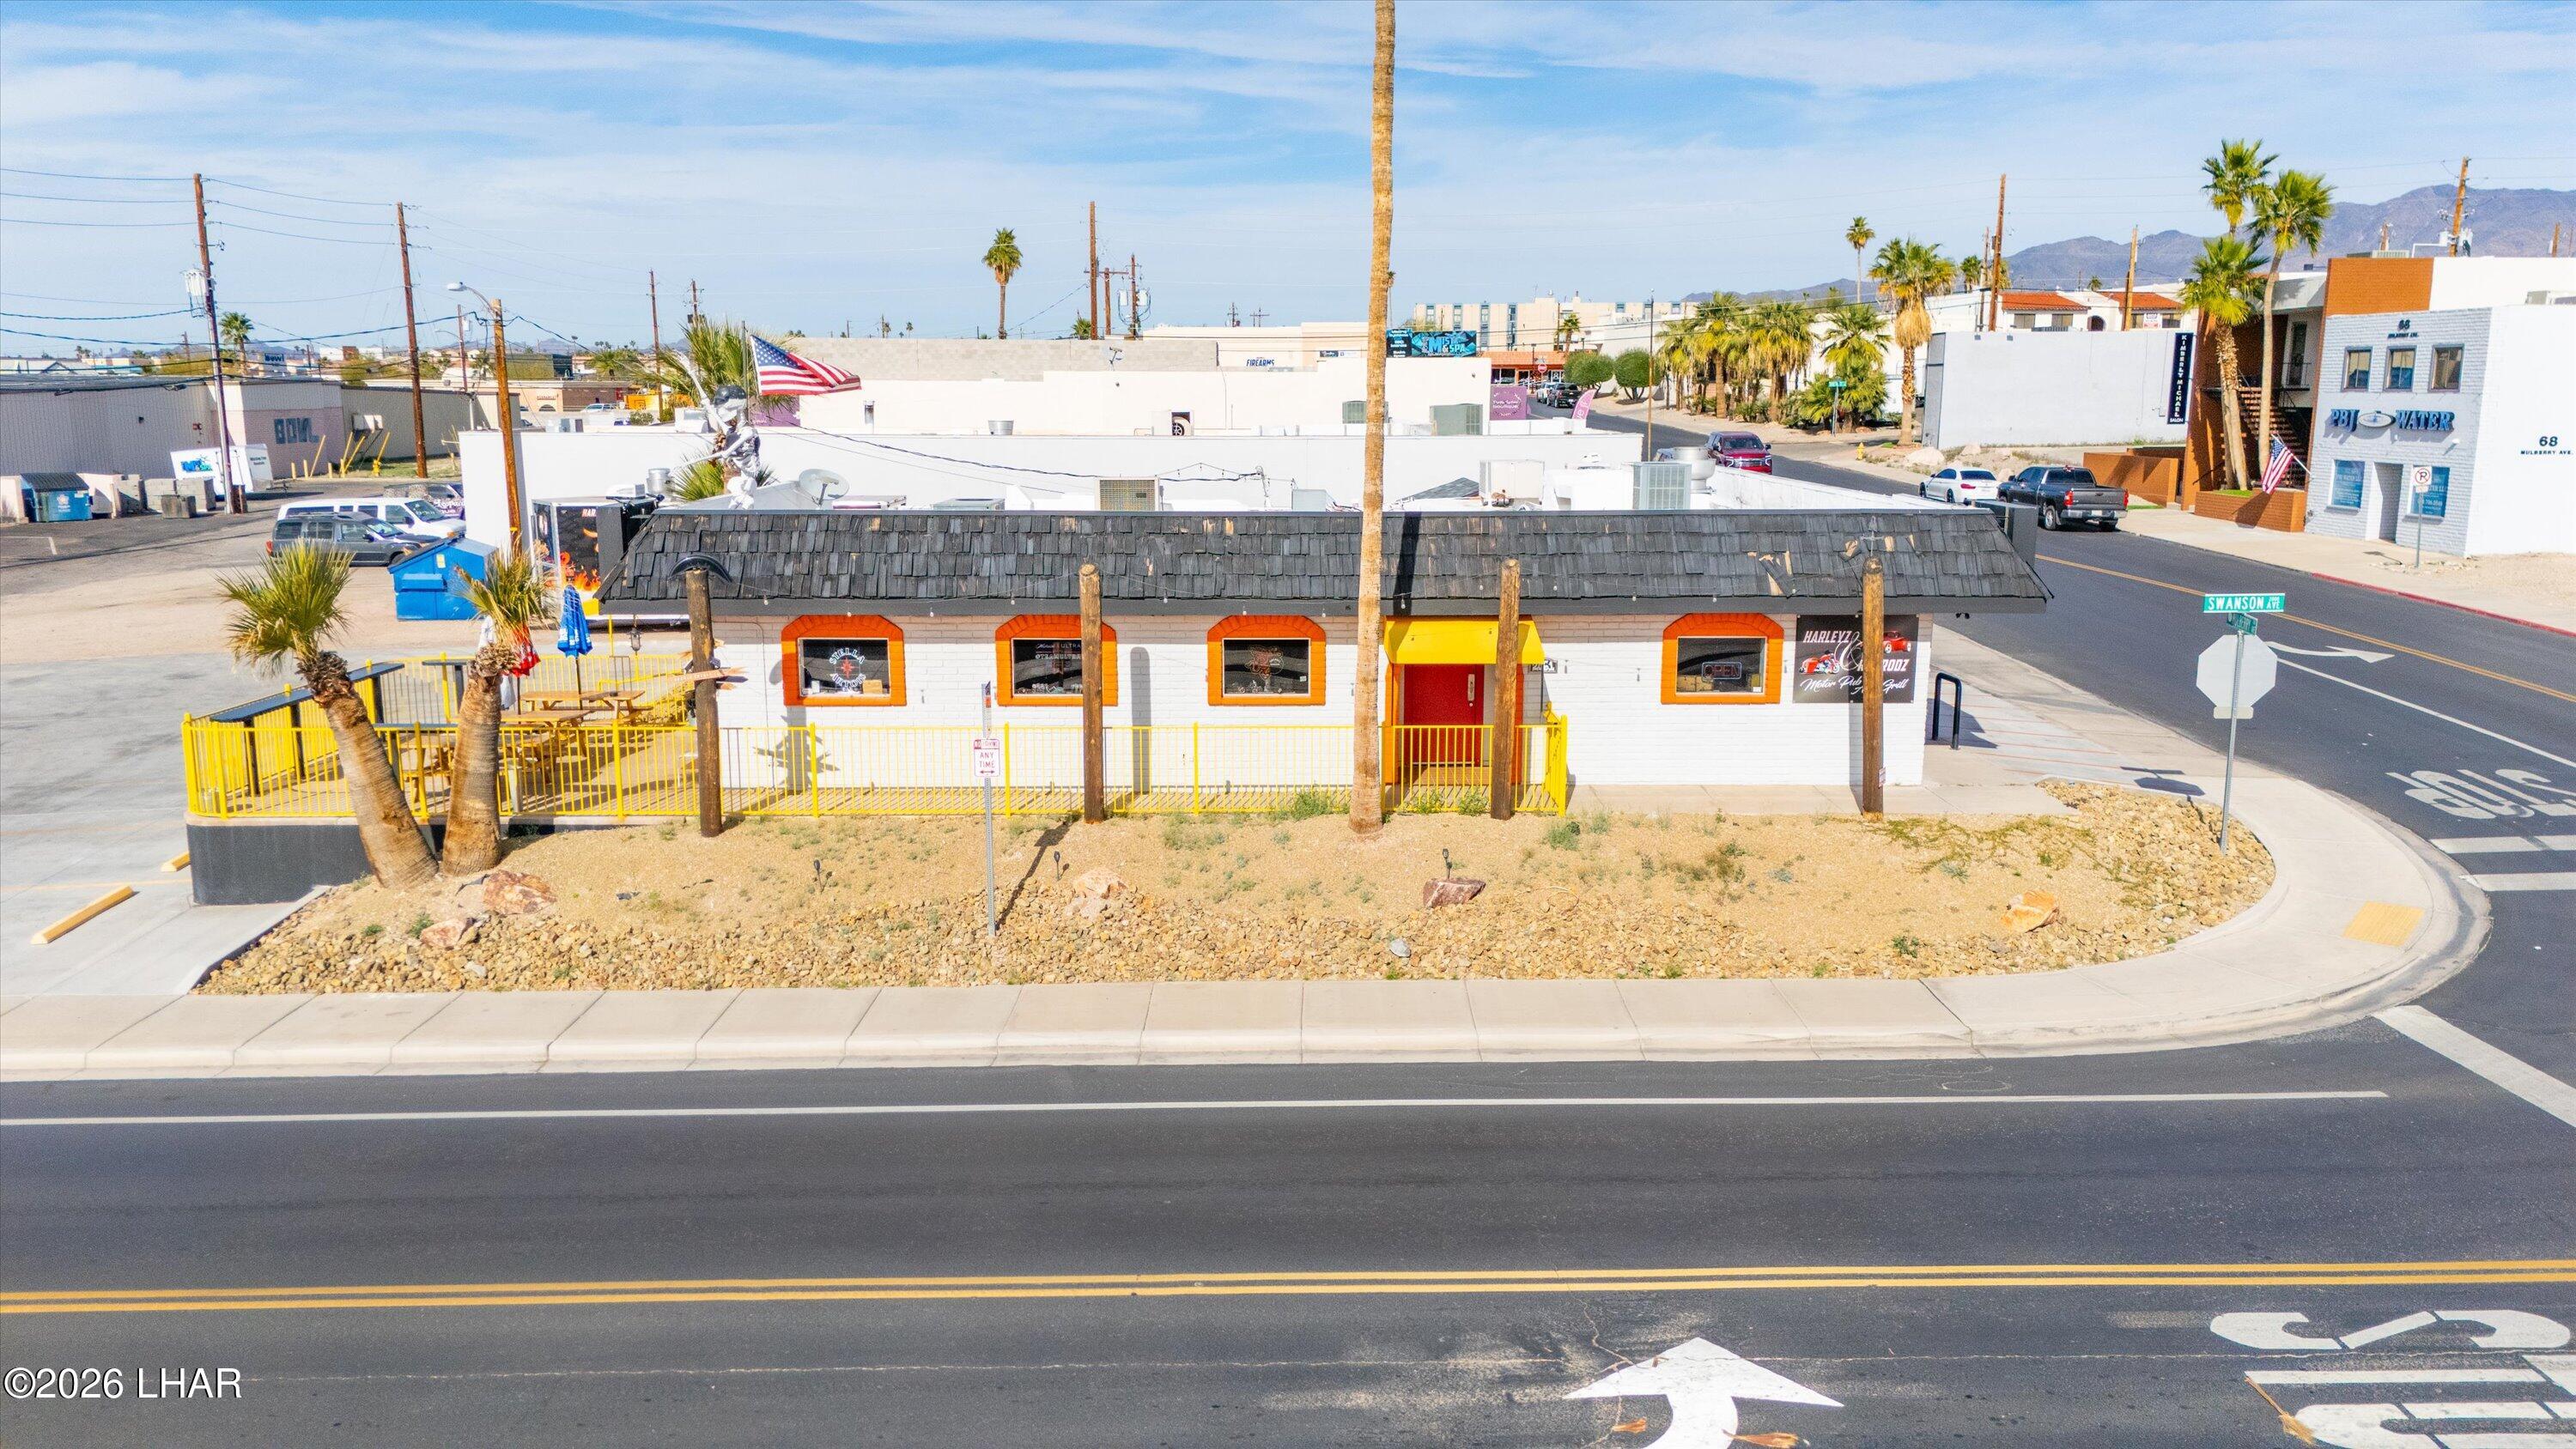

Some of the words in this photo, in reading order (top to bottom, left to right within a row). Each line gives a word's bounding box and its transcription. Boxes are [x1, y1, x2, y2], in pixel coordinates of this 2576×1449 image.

[2178, 335, 2187, 378] KIMBERLY
[2174, 379, 2184, 416] MICHAEL
[2330, 409, 2360, 432] PBJ
[2396, 409, 2455, 430] WATER
[274, 417, 319, 444] BOWL
[2539, 436, 2558, 446] 68
[581, 508, 597, 517] HAR
[2208, 596, 2264, 610] SWANSON
[2267, 601, 2280, 609] AVE
[1802, 630, 1853, 643] HARLEYZ
[829, 647, 866, 664] STELLA
[1800, 678, 1837, 692] Motor
[1838, 675, 1862, 689] Pub
[1883, 677, 1910, 694] Grill
[2210, 1310, 2576, 1449] STO
